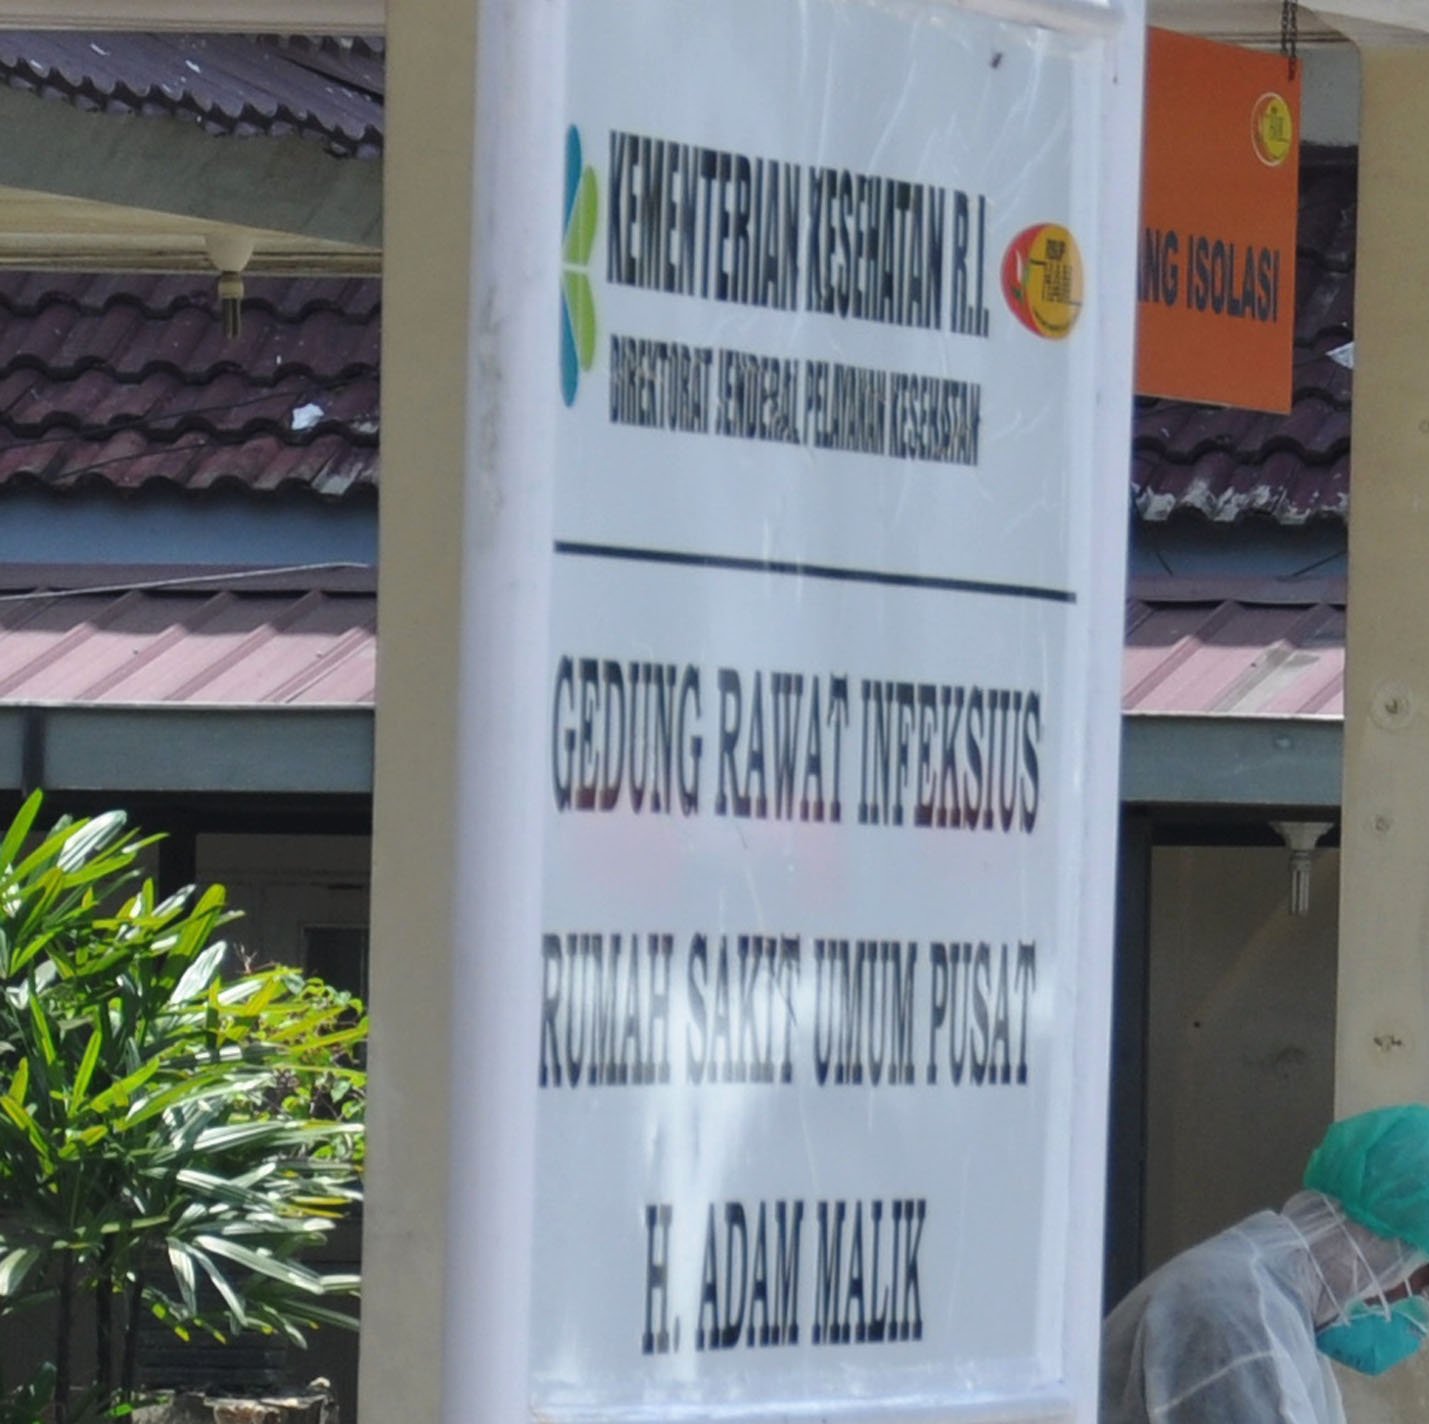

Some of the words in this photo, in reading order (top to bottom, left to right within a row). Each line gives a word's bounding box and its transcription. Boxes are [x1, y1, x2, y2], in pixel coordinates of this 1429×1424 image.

[606, 130, 801, 312] KEMENTERIAN
[805, 166, 946, 331] KESEHATAN
[951, 189, 989, 338] R.I.
[1187, 234, 1280, 323] ISOLASI
[609, 334, 712, 434] DIREKTORAT
[715, 349, 801, 445] JENDERAL
[803, 360, 887, 456] PELAYANAN
[889, 372, 981, 467] KESEHATAN
[552, 655, 703, 818] GEDUNG
[715, 667, 849, 824] RAWAT
[858, 679, 1041, 835] INFEKSIUS
[538, 933, 674, 1089] RUMAH
[686, 931, 801, 1086] SAKIT
[813, 939, 918, 1087] UMUM
[927, 940, 1036, 1088] PUSAT
[642, 1204, 680, 1355] H.
[695, 1200, 804, 1352] ADAM
[811, 1199, 926, 1346] MALIK
